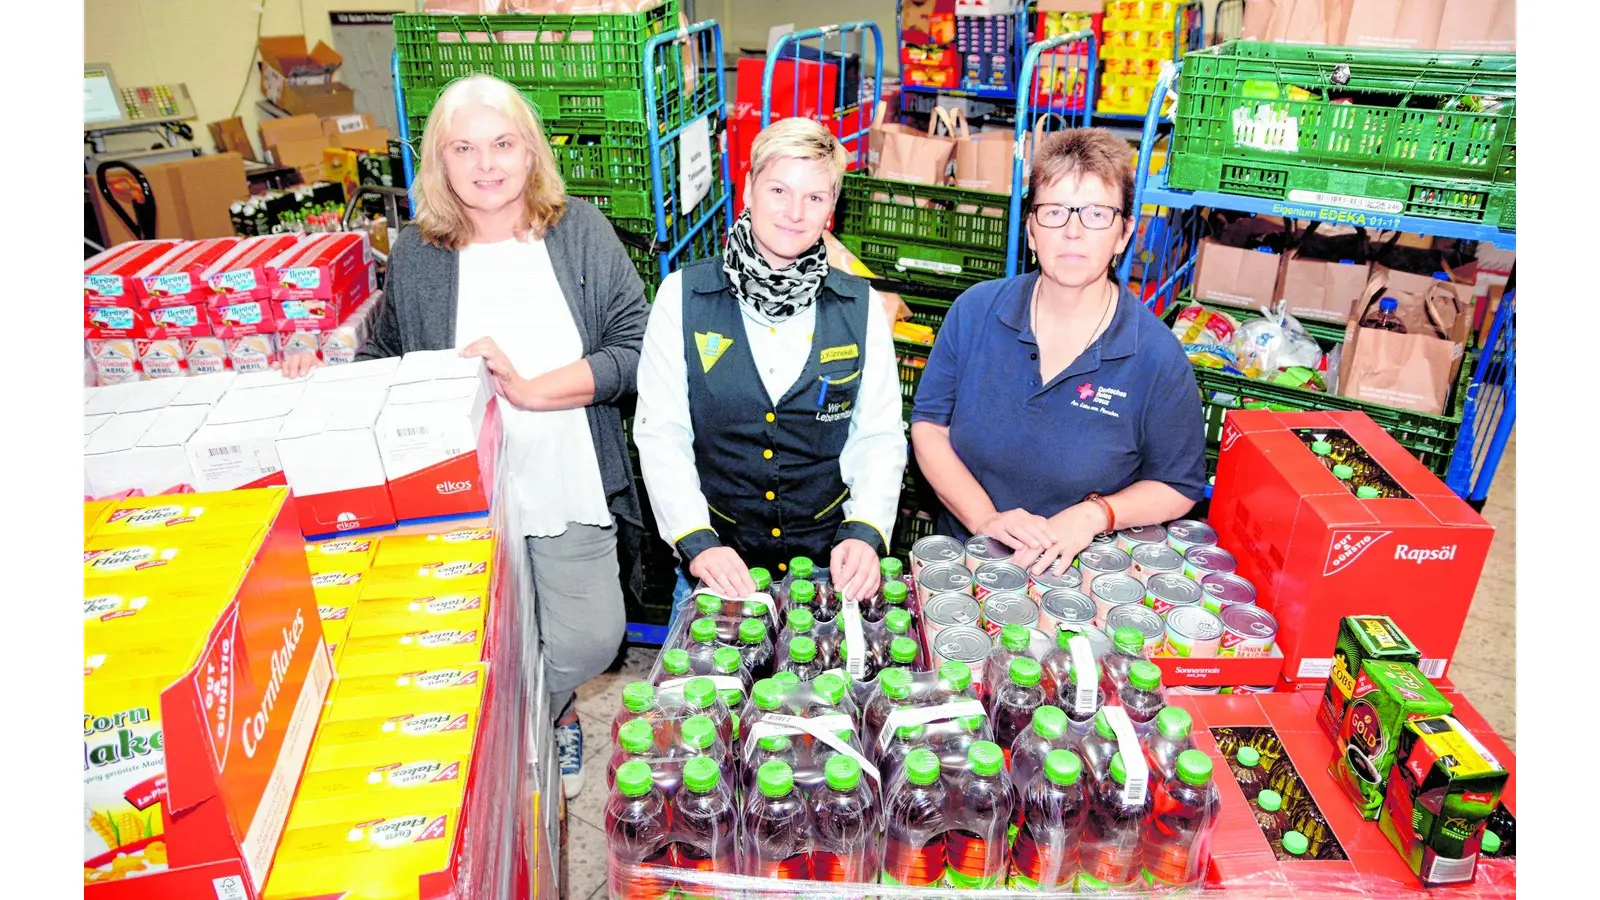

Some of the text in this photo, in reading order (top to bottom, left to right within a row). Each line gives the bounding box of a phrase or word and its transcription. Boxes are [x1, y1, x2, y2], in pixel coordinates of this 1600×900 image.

[1272, 204, 1316, 218] Eigentum
[1318, 208, 1366, 226] EDEKA
[828, 403, 840, 413] Wir
[436, 480, 472, 494] elkos
[336, 520, 360, 530] elkos
[1332, 535, 1372, 566] GÜNSTIG
[1334, 534, 1352, 550] GUT
[1394, 544, 1458, 565] Rapsöl
[1175, 666, 1220, 674] Sonnenmais
[1332, 664, 1352, 691] COBS
[206, 663, 214, 710] GUT
[216, 638, 230, 738] GÜNSTIG
[242, 608, 304, 758] Cornflakes
[84, 706, 150, 737] Corn
[1352, 714, 1376, 748] GOLD
[374, 816, 428, 834] Flakes
